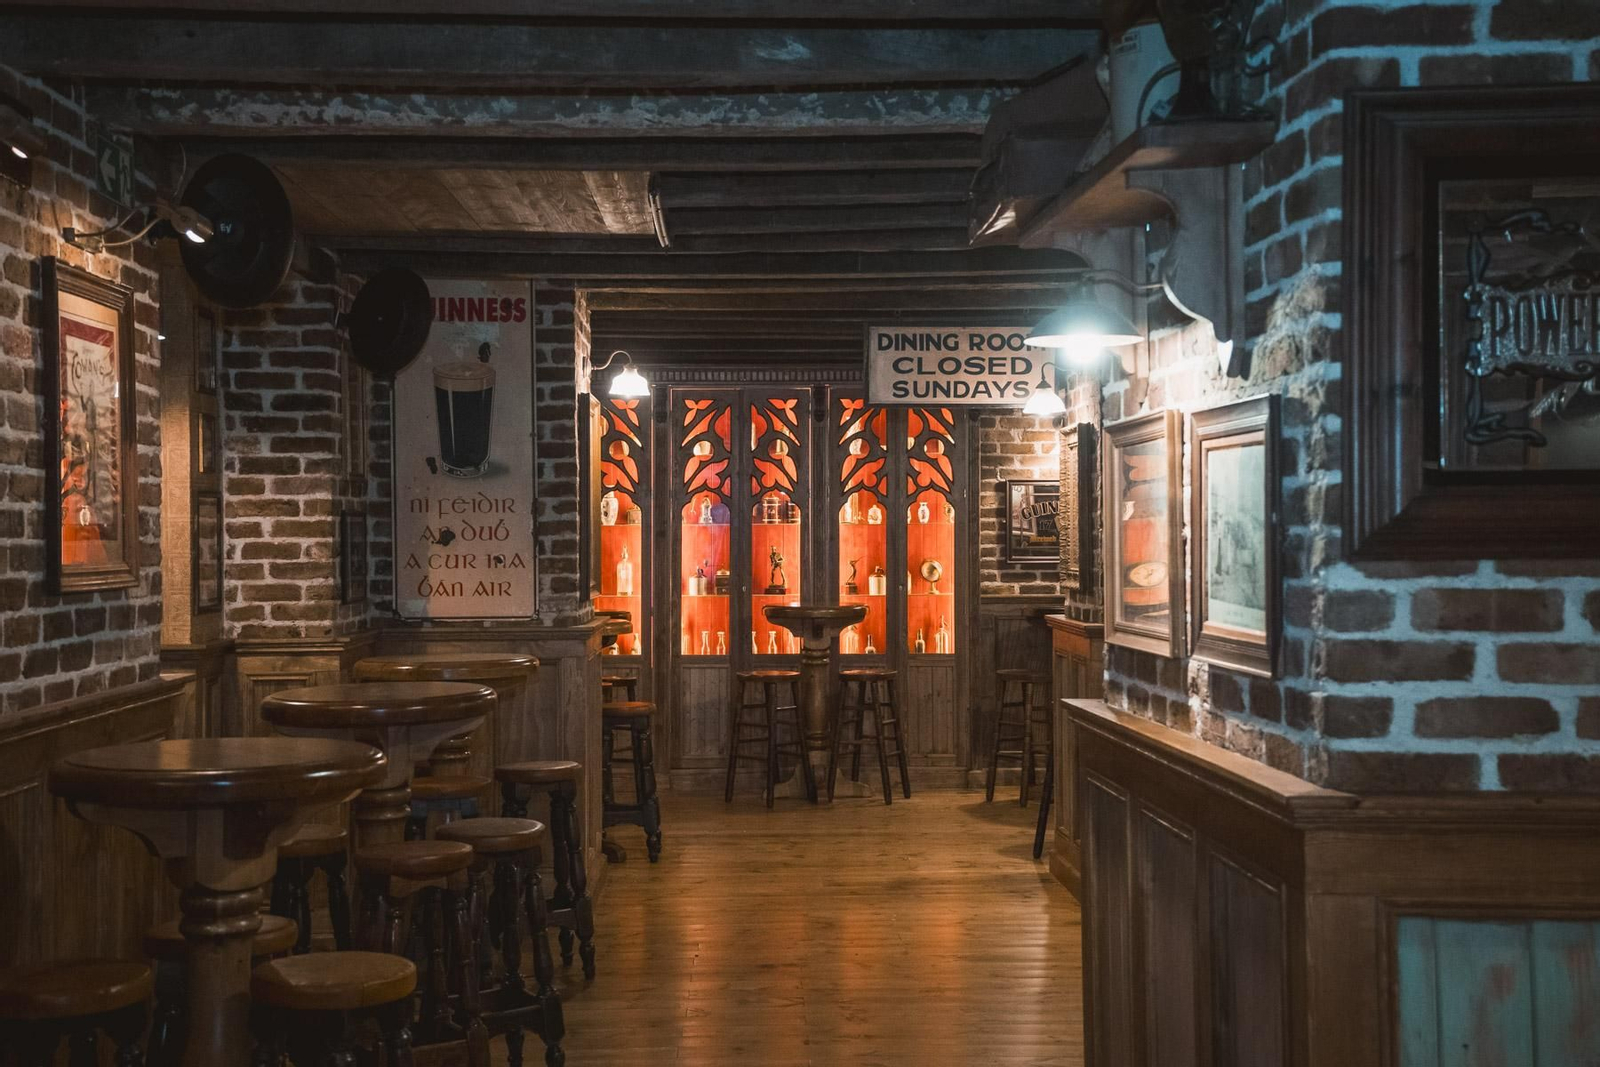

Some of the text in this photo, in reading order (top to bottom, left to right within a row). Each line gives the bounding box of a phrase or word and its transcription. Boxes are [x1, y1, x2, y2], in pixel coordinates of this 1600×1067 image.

[432, 297, 527, 323] INNESS
[1490, 293, 1600, 354] POWE
[877, 332, 959, 352] DINING
[892, 356, 1033, 376] CLOSED
[892, 380, 1031, 399] SUNDAYS
